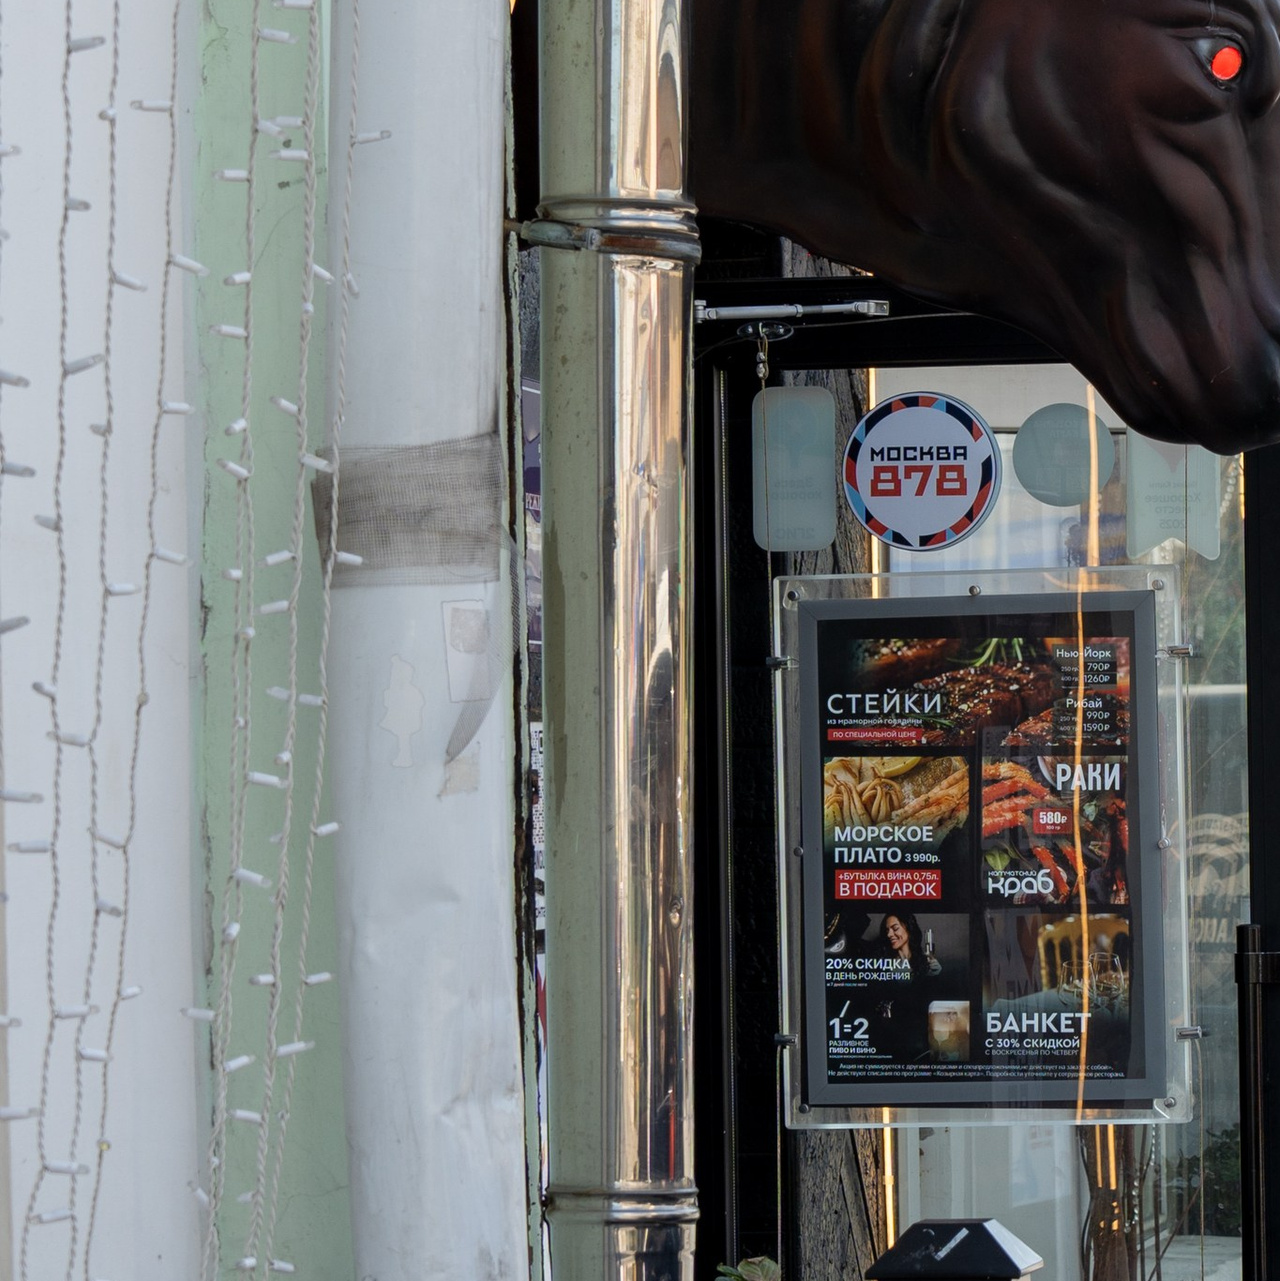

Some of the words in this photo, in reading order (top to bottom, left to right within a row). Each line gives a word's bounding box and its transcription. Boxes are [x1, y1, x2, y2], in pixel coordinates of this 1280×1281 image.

[870, 445, 967, 462] МОСКВА
[870, 464, 968, 497] 878
[1056, 646, 1111, 659] Нью-Йорк
[827, 688, 941, 714] СТЕЙКИ
[1066, 698, 1102, 708] Рибай
[838, 718, 883, 726] мраморной
[884, 718, 922, 727] говядины
[845, 730, 897, 738] СПЕЦИАЛЬНОЙ
[1056, 763, 1120, 791] РАКИ
[834, 826, 933, 842] МОРСКОЕ
[834, 847, 902, 863] ПЛАТО
[838, 872, 886, 880] +БУТЫЛКА
[887, 872, 912, 880] ВИНА
[988, 869, 1054, 898] краб
[840, 882, 850, 896] В
[854, 882, 936, 899] ПОДАРОК
[825, 958, 853, 969] 20%
[855, 958, 911, 971] СКИДКА
[825, 972, 832, 980] В
[833, 972, 857, 981] ДЕНЬ
[858, 972, 911, 981] РОЖДЕНИЯ
[986, 1012, 1092, 1033] БАНКЕТ
[985, 1039, 993, 1048] С
[996, 1038, 1020, 1048] 30%
[1023, 1036, 1080, 1049] СКИДКОЙ
